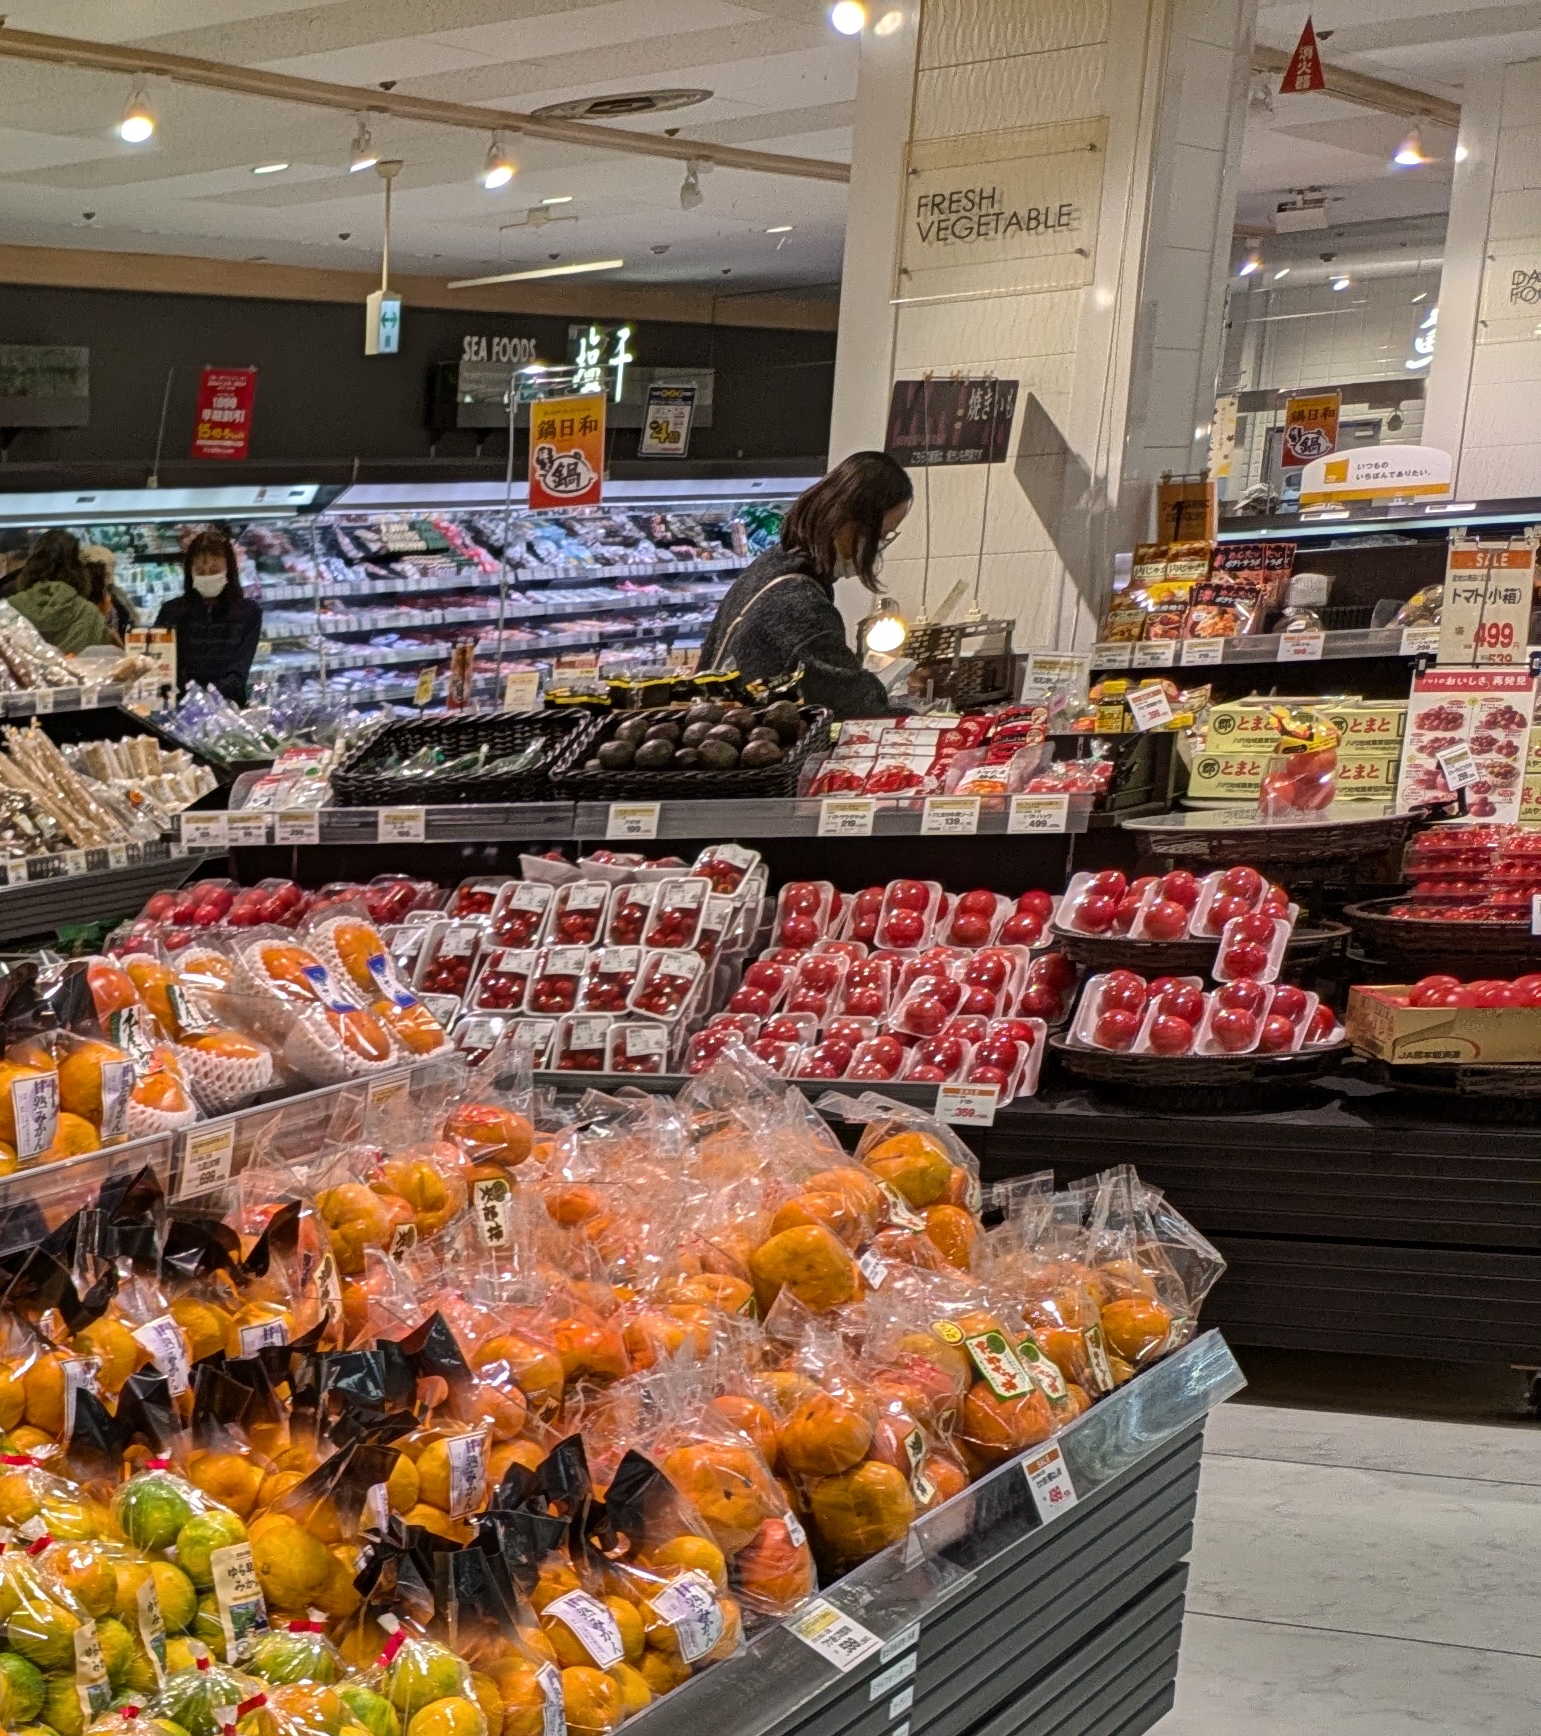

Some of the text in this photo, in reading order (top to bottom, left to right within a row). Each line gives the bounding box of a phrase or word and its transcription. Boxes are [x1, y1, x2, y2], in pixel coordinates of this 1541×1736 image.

[1295, 44, 1313, 91] 消火器
[917, 186, 997, 218] FRESH
[917, 203, 1073, 243] VEGETABLE
[462, 335, 538, 363] SEA FOODS
[536, 415, 599, 441] 鍋日和
[551, 461, 582, 489] 鍋
[1356, 460, 1389, 471] いつもの
[1452, 587, 1522, 605] トマト(小箱)
[1473, 622, 1514, 649] 499
[1349, 718, 1391, 734] とまと
[1220, 760, 1262, 777] とまと
[1338, 763, 1381, 780] とまと
[29, 1075, 56, 1156] 甘熟みかん
